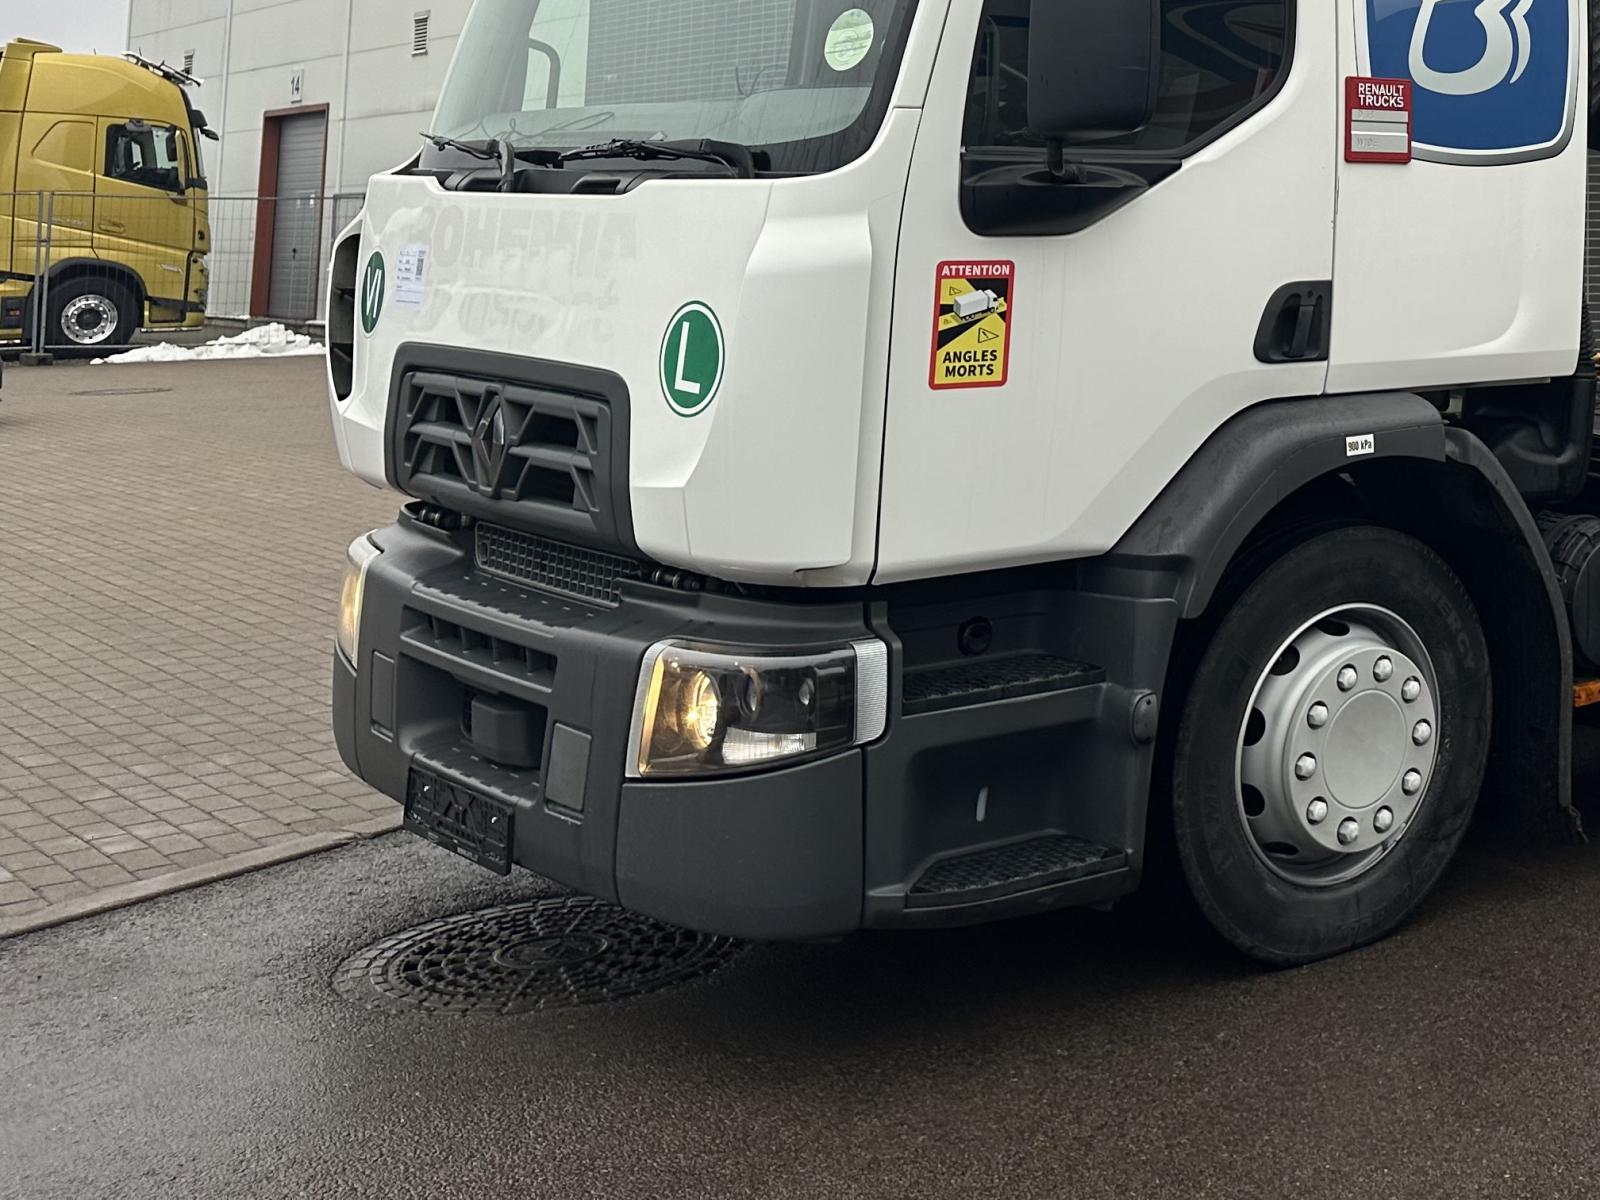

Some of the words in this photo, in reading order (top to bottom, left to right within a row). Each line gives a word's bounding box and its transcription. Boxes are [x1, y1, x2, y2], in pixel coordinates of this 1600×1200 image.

[290, 75, 300, 96] 14
[1358, 82, 1405, 97] RENAULT
[1358, 94, 1405, 108] TRUCKS
[941, 264, 1010, 276] ATTENTION
[674, 320, 702, 395] L
[942, 349, 998, 364] ANGLES
[944, 363, 995, 378] MORTS
[1361, 439, 1372, 450] kPa
